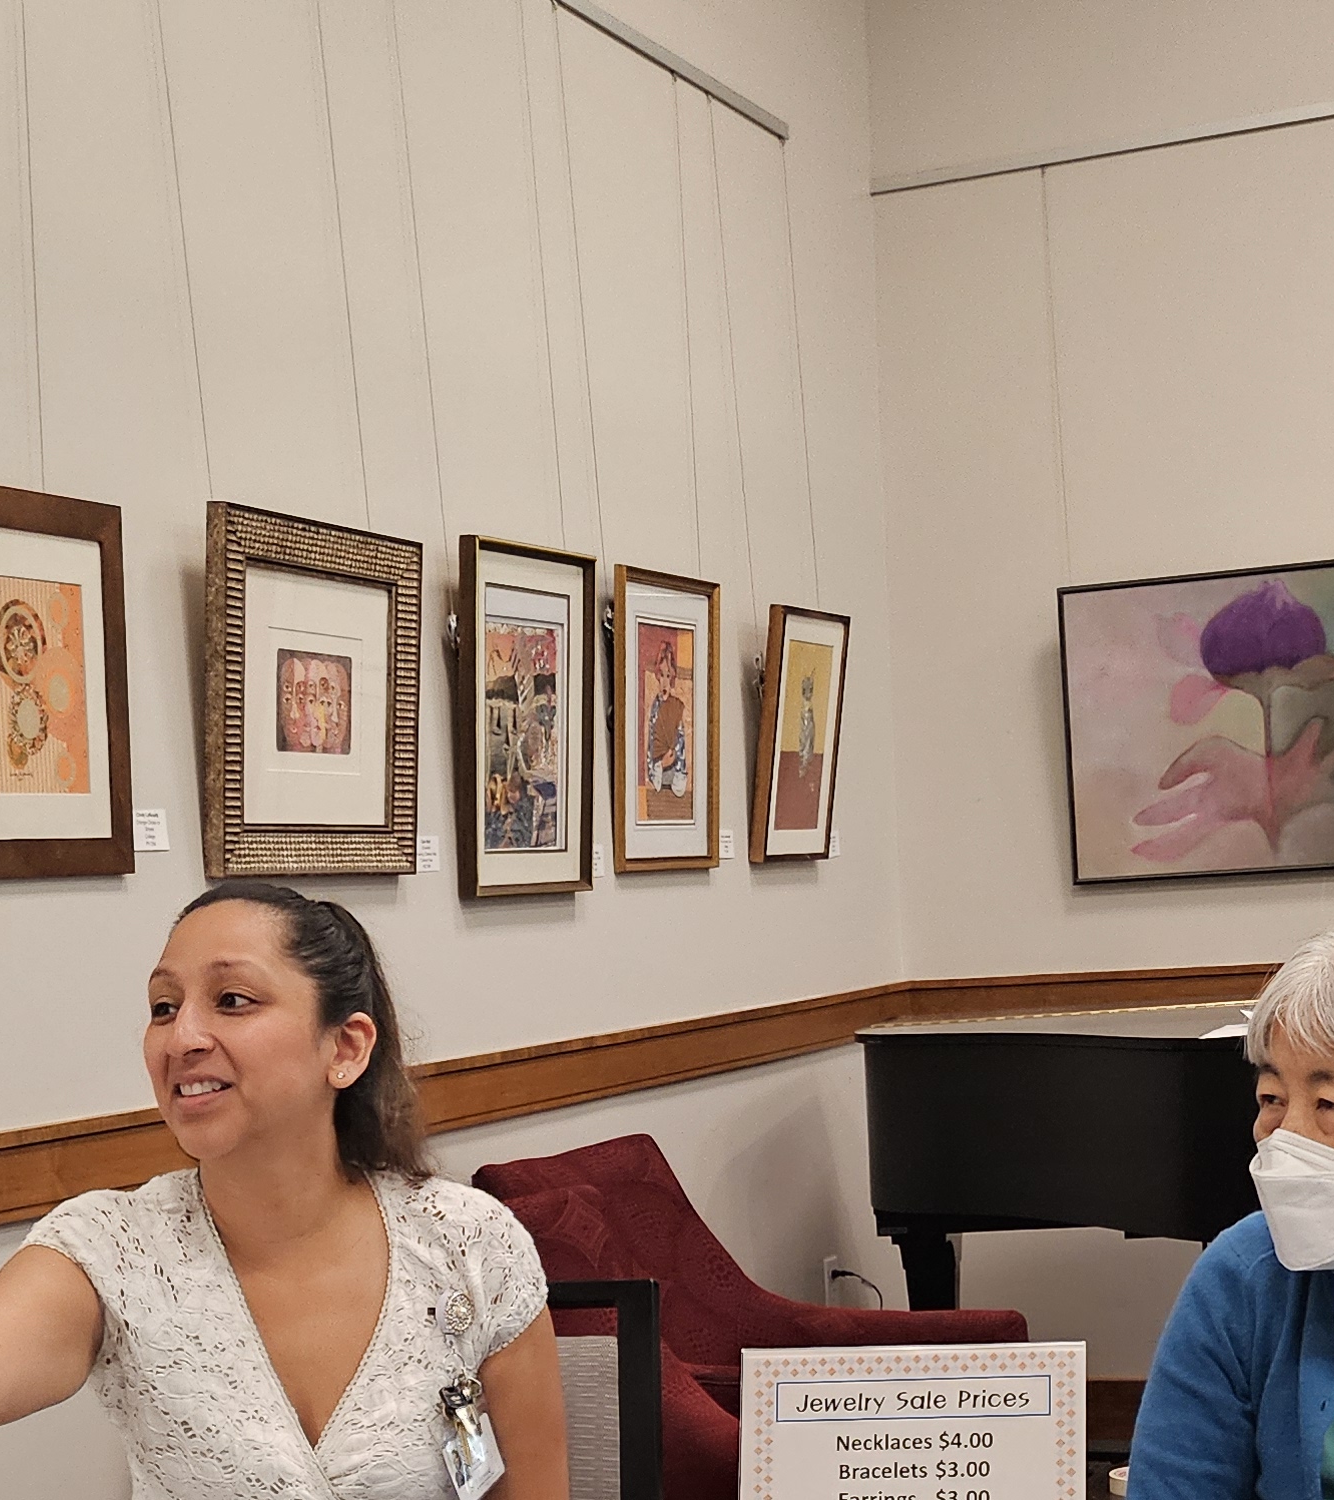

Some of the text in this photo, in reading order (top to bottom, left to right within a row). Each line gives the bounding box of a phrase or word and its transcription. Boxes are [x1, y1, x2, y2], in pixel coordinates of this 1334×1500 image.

[796, 1389, 1030, 1415] Jewelry Sale Prices
[836, 1430, 993, 1452] Necklaces $4.00
[839, 1459, 990, 1481] Bracelets $3.00
